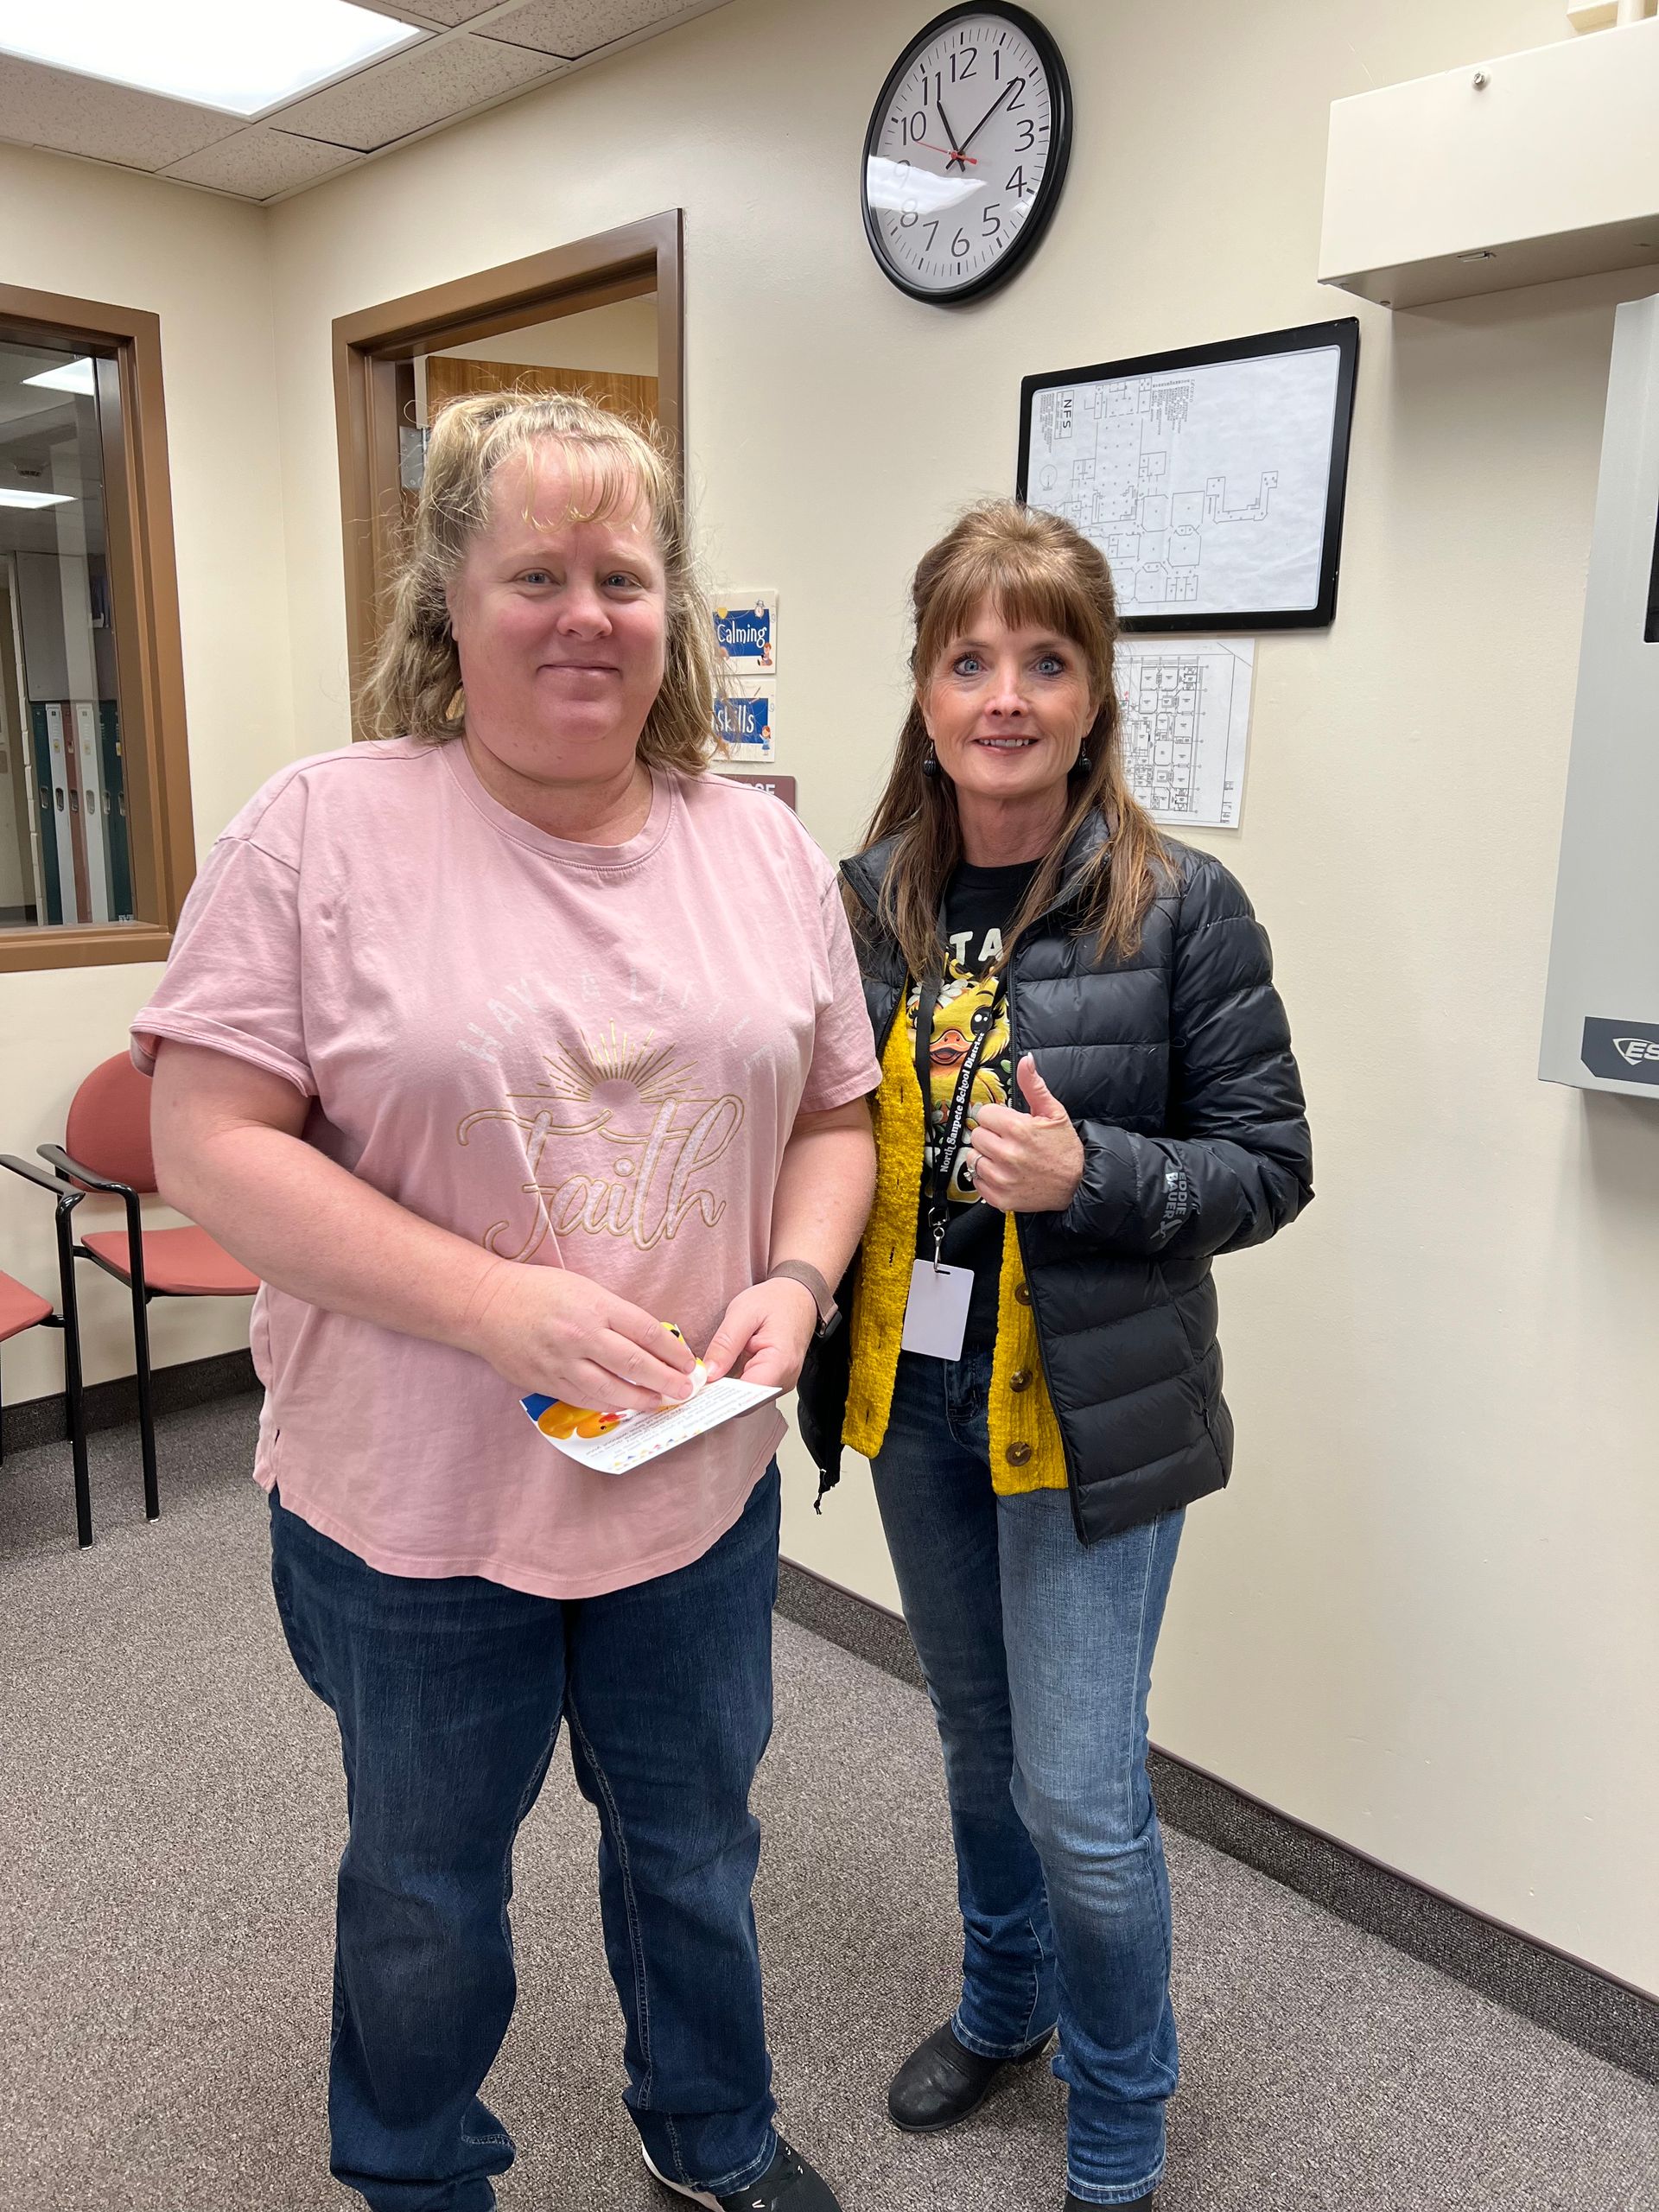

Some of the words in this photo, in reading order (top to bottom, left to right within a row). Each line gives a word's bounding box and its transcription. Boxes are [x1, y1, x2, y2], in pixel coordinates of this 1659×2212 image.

[950, 47, 977, 83] 12
[993, 49, 1000, 80] 1
[922, 71, 941, 105] 11
[1007, 77, 1026, 111] 2
[901, 111, 926, 146] 10
[1014, 119, 1035, 151] 3
[893, 160, 911, 188] 9
[1005, 165, 1027, 198] 4
[900, 197, 918, 228] 8
[982, 204, 1001, 237] 5
[923, 220, 939, 251] 7
[951, 227, 970, 257] 6
[1062, 398, 1072, 429] NFS
[717, 620, 767, 649] Calming
[963, 1032, 985, 1071] District
[956, 1069, 971, 1104] School
[946, 1104, 964, 1146] Sanpete
[939, 1144, 957, 1173] North
[456, 1094, 745, 1263] Faith
[1175, 1172, 1188, 1216] EDDIE
[1163, 1172, 1179, 1219] BAUER
